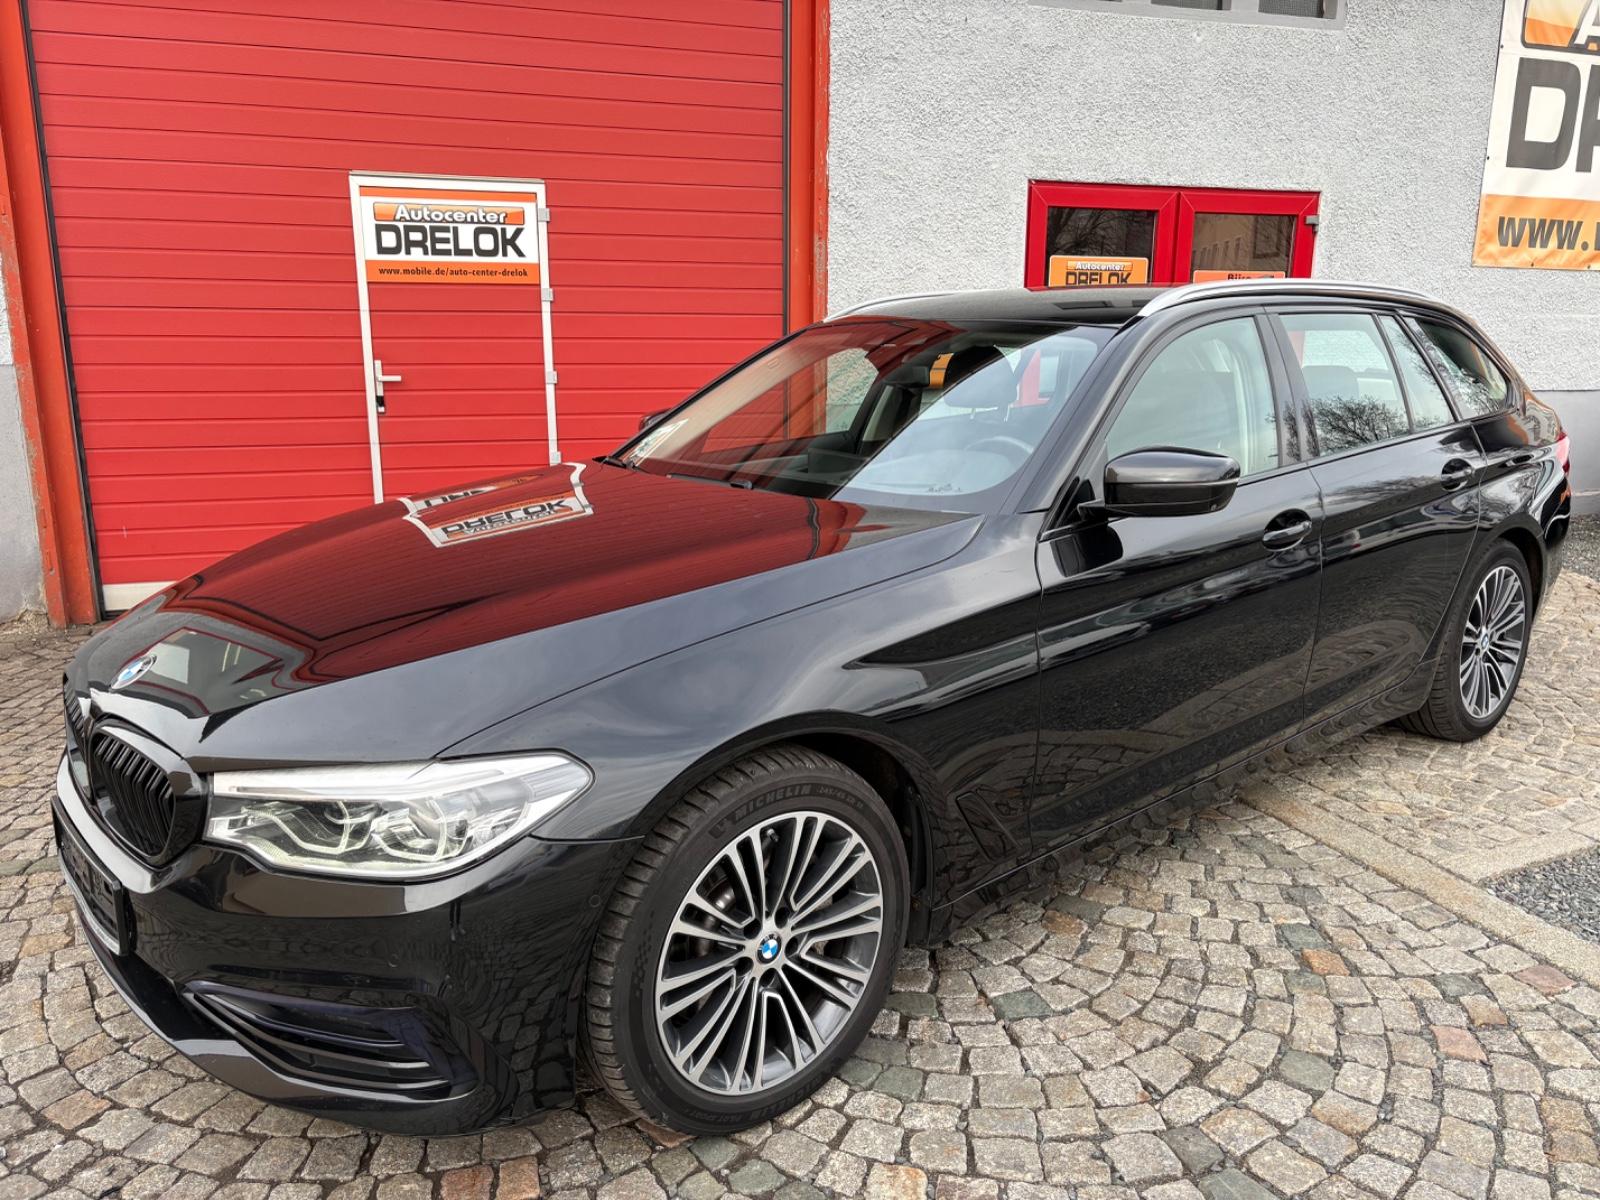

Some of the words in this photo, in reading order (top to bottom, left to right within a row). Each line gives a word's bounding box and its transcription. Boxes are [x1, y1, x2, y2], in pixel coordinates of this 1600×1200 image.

[394, 204, 508, 224] Autocenter
[375, 223, 526, 258] DRELOK
[1497, 216, 1600, 251] www.
[378, 267, 528, 277] www.mobile.de/auto-center-drelok
[1075, 261, 1126, 271] Autocenter
[734, 784, 814, 822] MICHELIN
